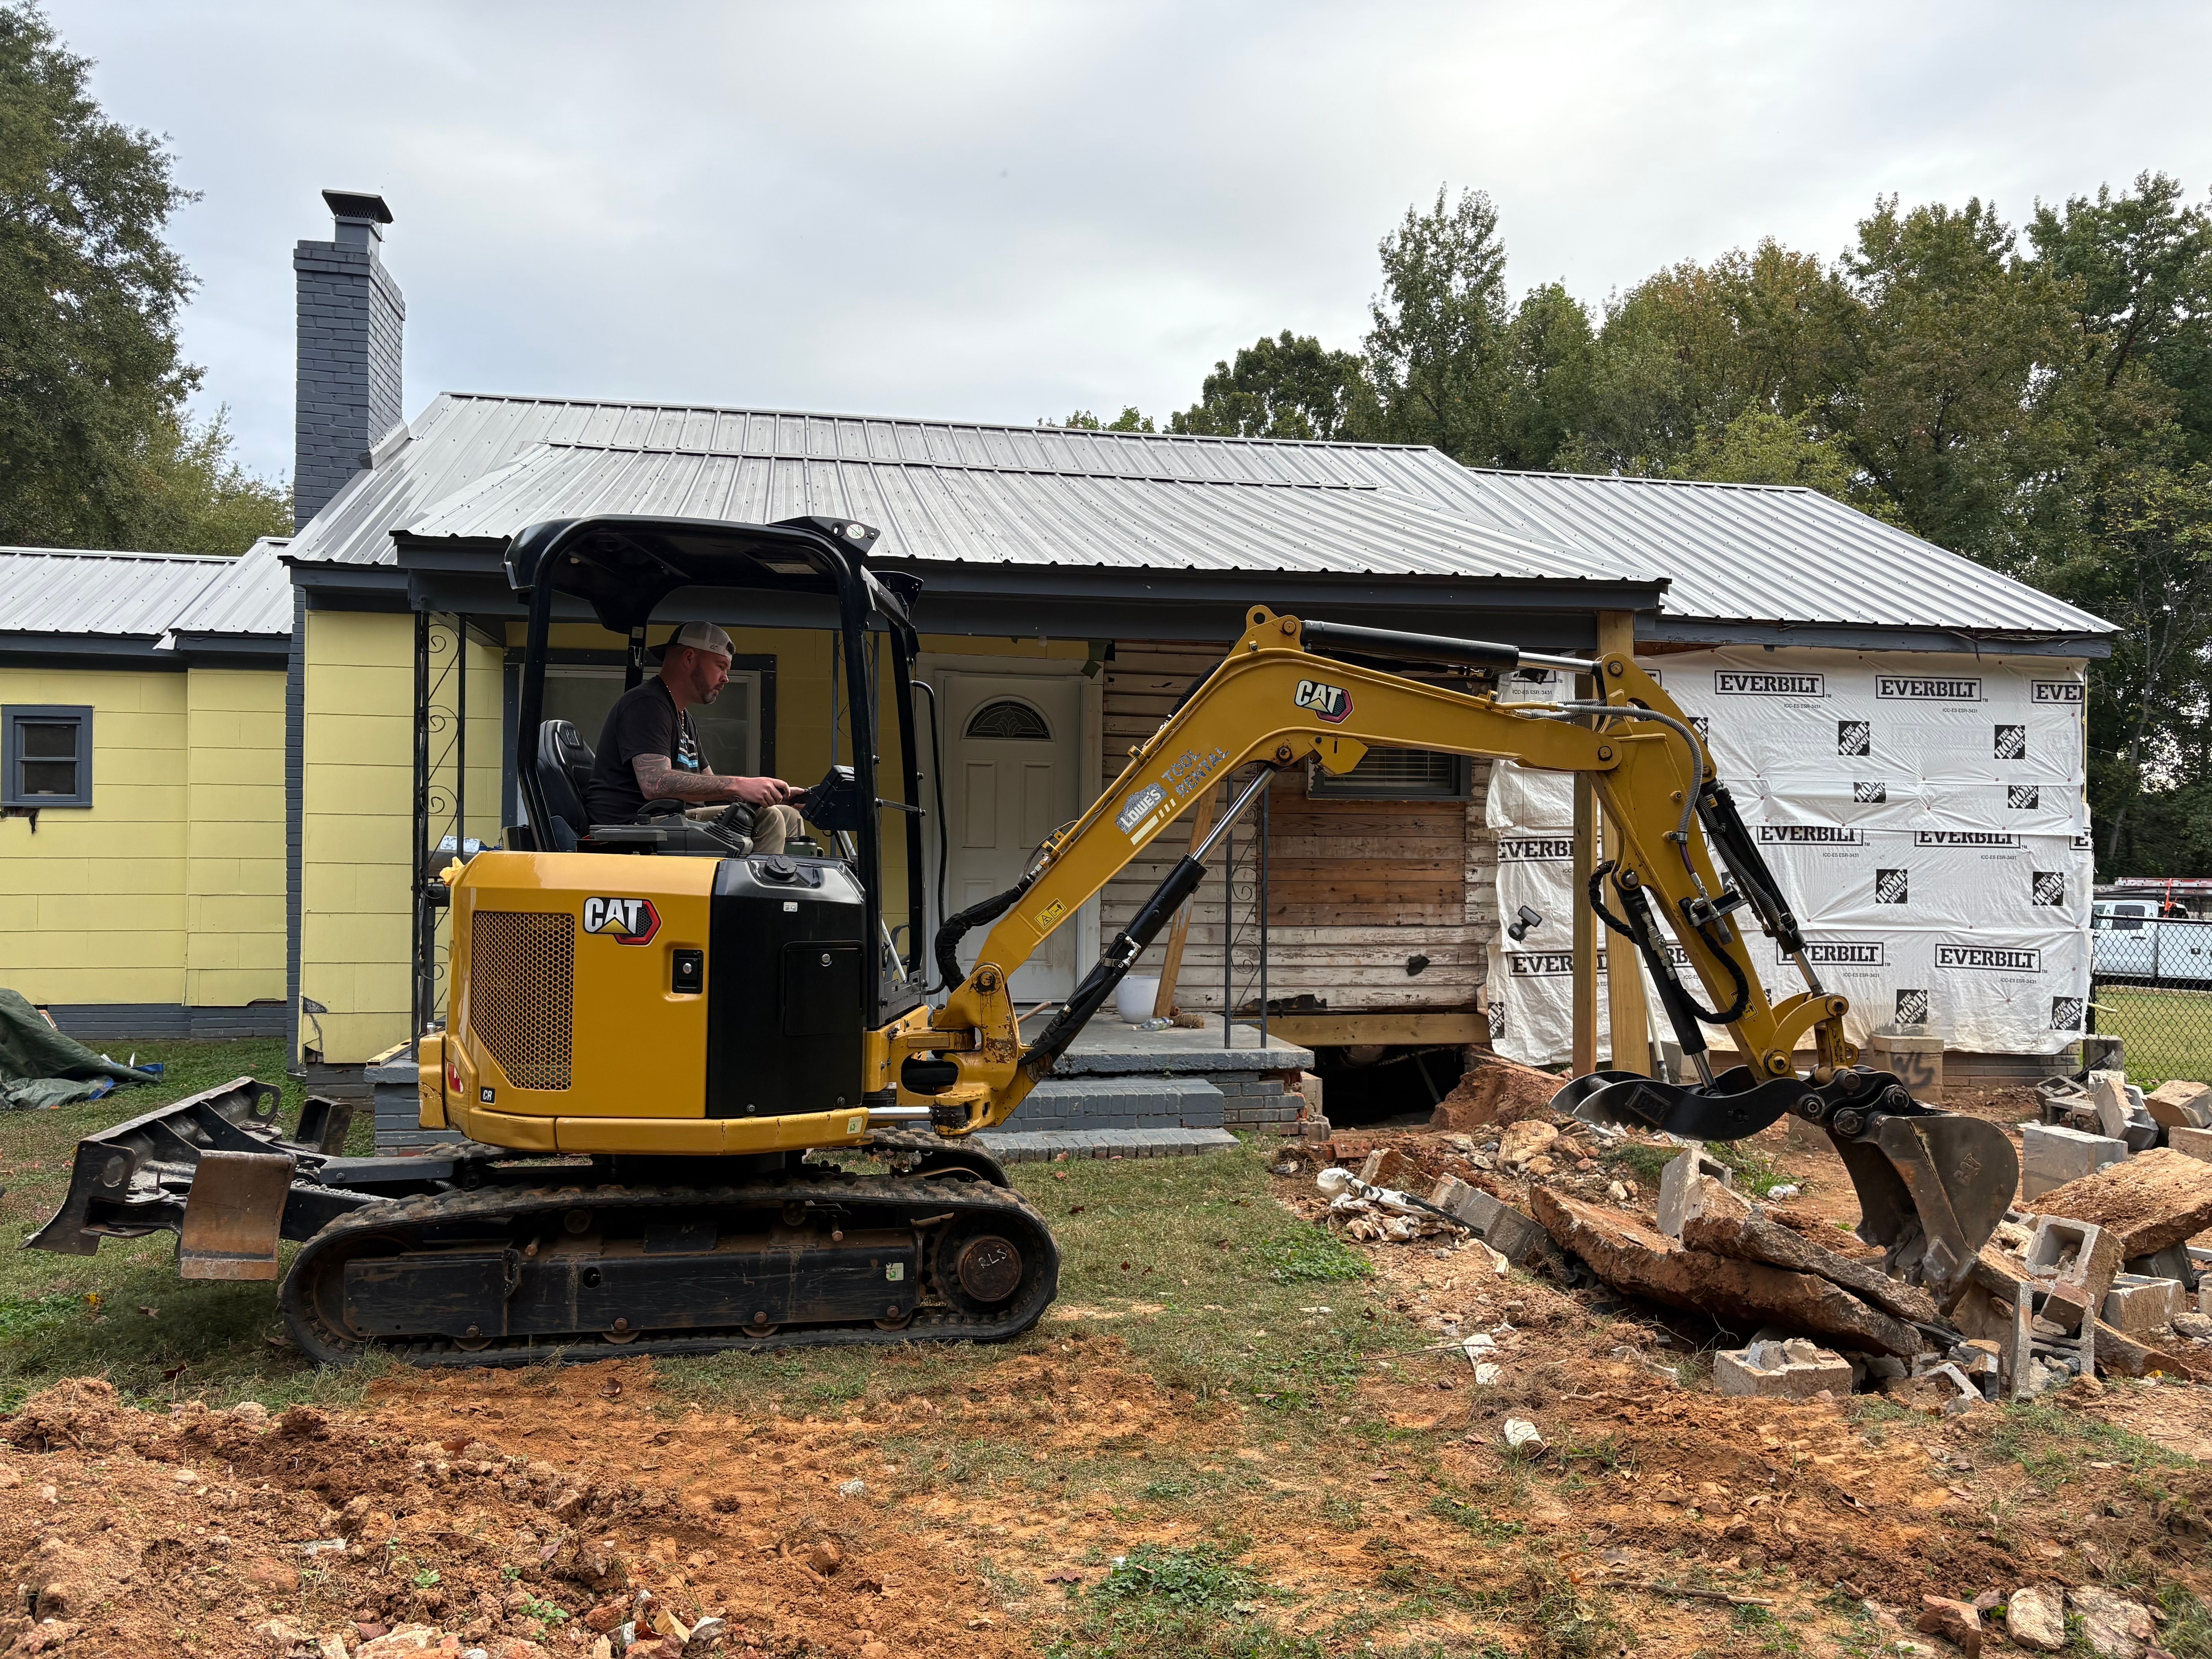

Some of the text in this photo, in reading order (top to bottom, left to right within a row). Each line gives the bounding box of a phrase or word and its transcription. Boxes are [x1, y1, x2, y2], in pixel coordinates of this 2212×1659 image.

[1720, 675, 1819, 693] EVERBILT
[1881, 680, 1977, 697] EVERBILT
[1296, 680, 1342, 713] CAT
[1838, 721, 1870, 755] HOME
[1841, 724, 1854, 738] THE
[1997, 728, 2010, 742] THE
[1850, 734, 1870, 755] DEPOT
[1994, 725, 2025, 759] HOME
[2006, 738, 2025, 759] DEPOT
[1161, 749, 1202, 783] TOOL
[1175, 747, 1230, 798] RENTAL
[1120, 788, 1161, 828] LOWE'S
[2020, 787, 2038, 809] DEPOT
[1761, 826, 1855, 841] EVERBILT
[1876, 869, 1907, 903] HOME
[1879, 872, 1892, 886] THE
[2033, 872, 2064, 905] HOME
[2035, 875, 2049, 888] THE
[1888, 882, 1907, 903] DEPOT
[2045, 884, 2064, 905] DEPOT
[585, 898, 642, 934] CAT
[1782, 946, 1879, 962] ERBILT
[1940, 948, 2035, 968] EVERBILT
[1896, 989, 1927, 1023] HOME
[1899, 993, 1913, 1006] THE
[2054, 1000, 2066, 1013] THE
[1908, 1002, 1927, 1023] DEPOT
[2051, 997, 2083, 1029] HOME
[2059, 1010, 2081, 1030] DEPOT
[1490, 1015, 1504, 1038] EPOT
[483, 1090, 492, 1101] CR
